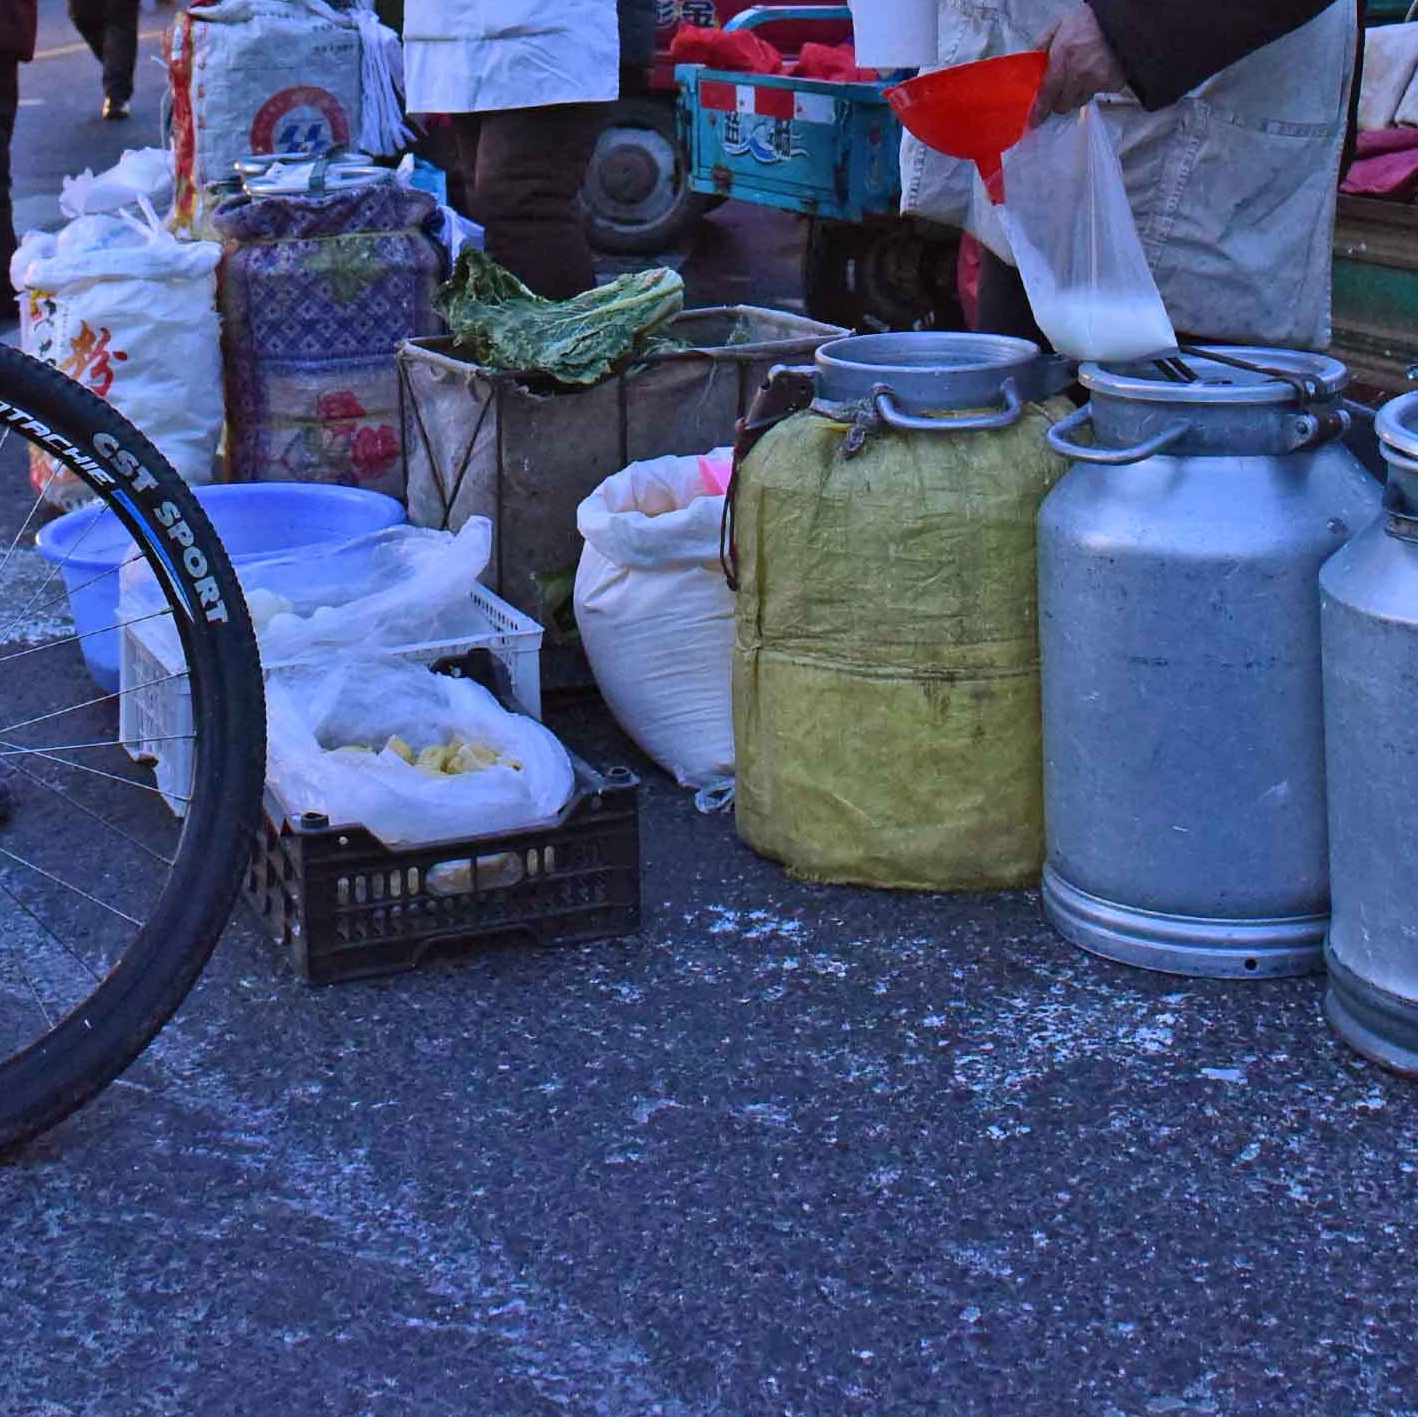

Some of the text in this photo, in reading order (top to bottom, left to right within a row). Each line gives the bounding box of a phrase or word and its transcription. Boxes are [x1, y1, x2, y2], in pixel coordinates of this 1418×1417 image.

[59, 319, 128, 397] 粉
[93, 432, 228, 623] CST SPORT
